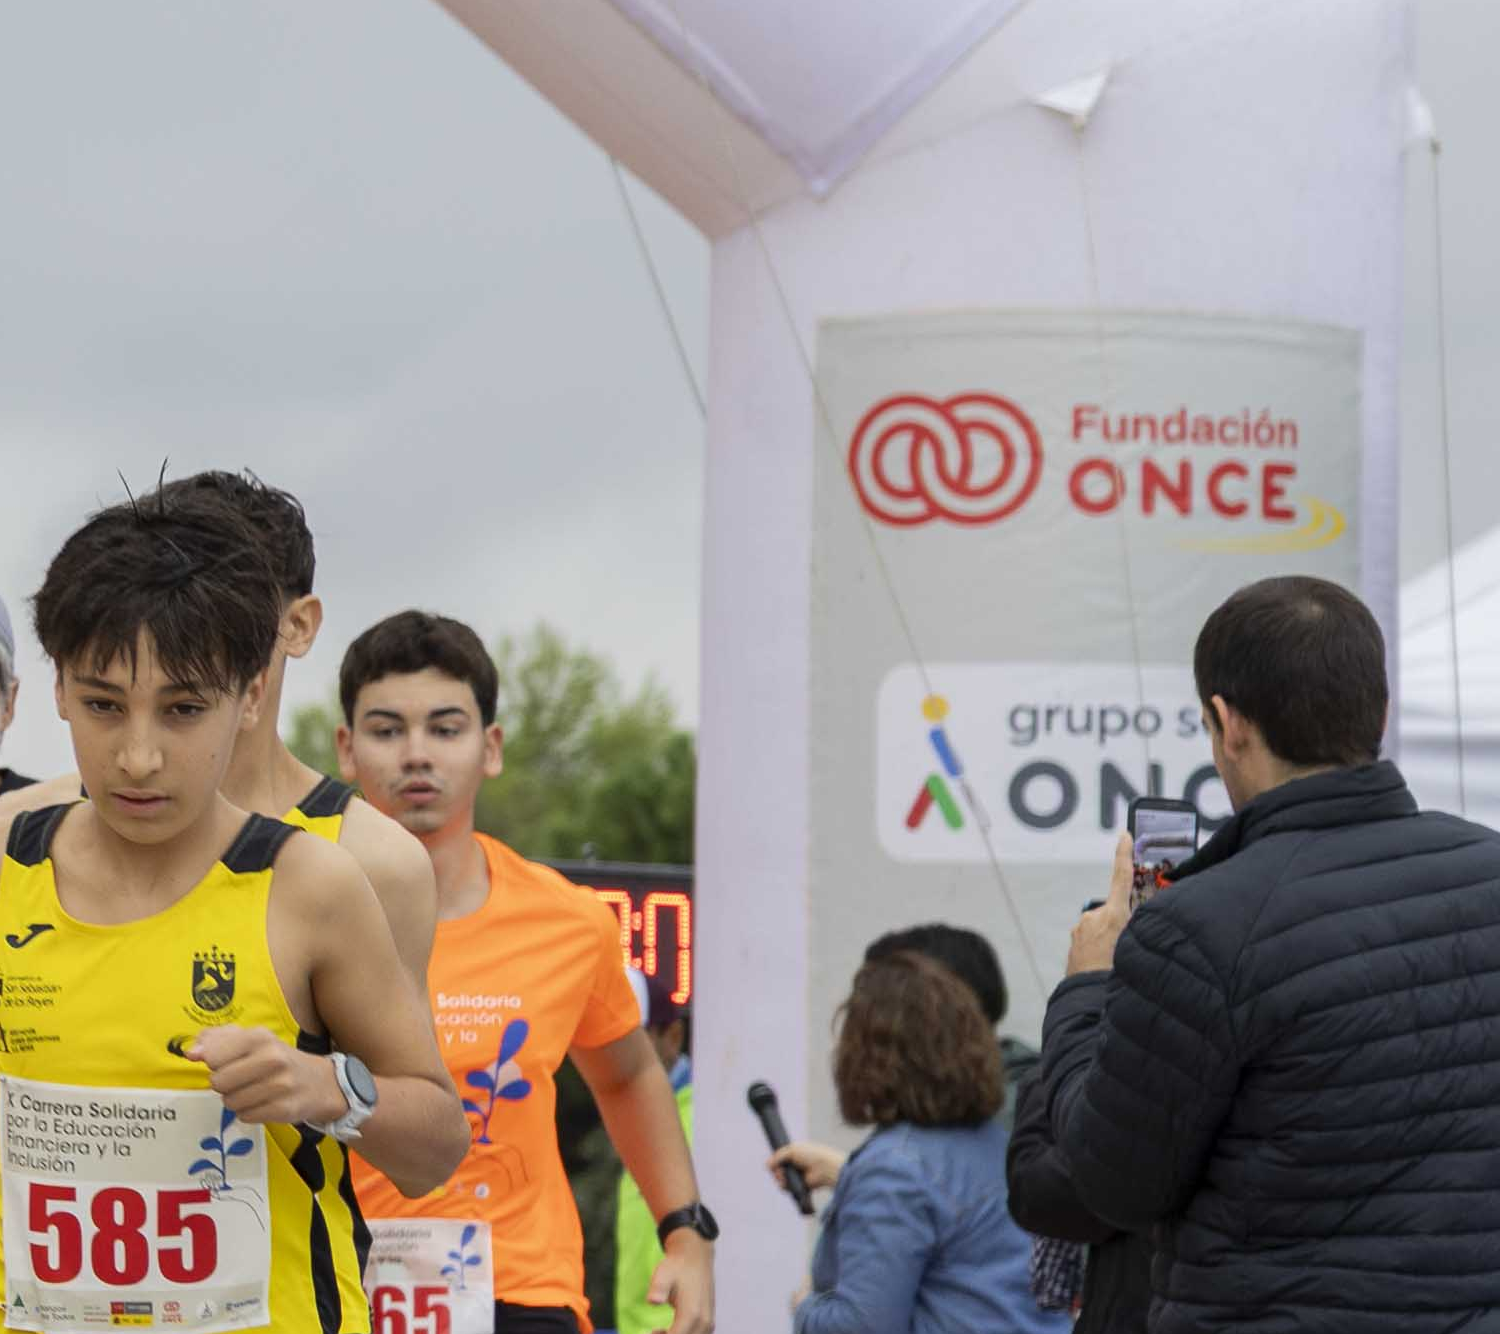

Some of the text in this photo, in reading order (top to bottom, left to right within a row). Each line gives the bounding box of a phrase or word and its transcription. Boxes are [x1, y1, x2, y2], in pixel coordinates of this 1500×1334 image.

[1071, 404, 1299, 449] Fundación
[1067, 457, 1297, 522] ONCE
[1007, 702, 1163, 747] grupo
[1007, 758, 1233, 834] ONC
[436, 992, 523, 1010] Solidaria
[434, 1012, 503, 1028] cación
[19, 1094, 83, 1117] Carrera
[88, 1102, 178, 1122] Solidaria
[6, 1112, 157, 1140] por la Educación
[6, 1128, 132, 1159] Financiera y la
[7, 1147, 76, 1173] Inclusión
[28, 1181, 218, 1287] 585
